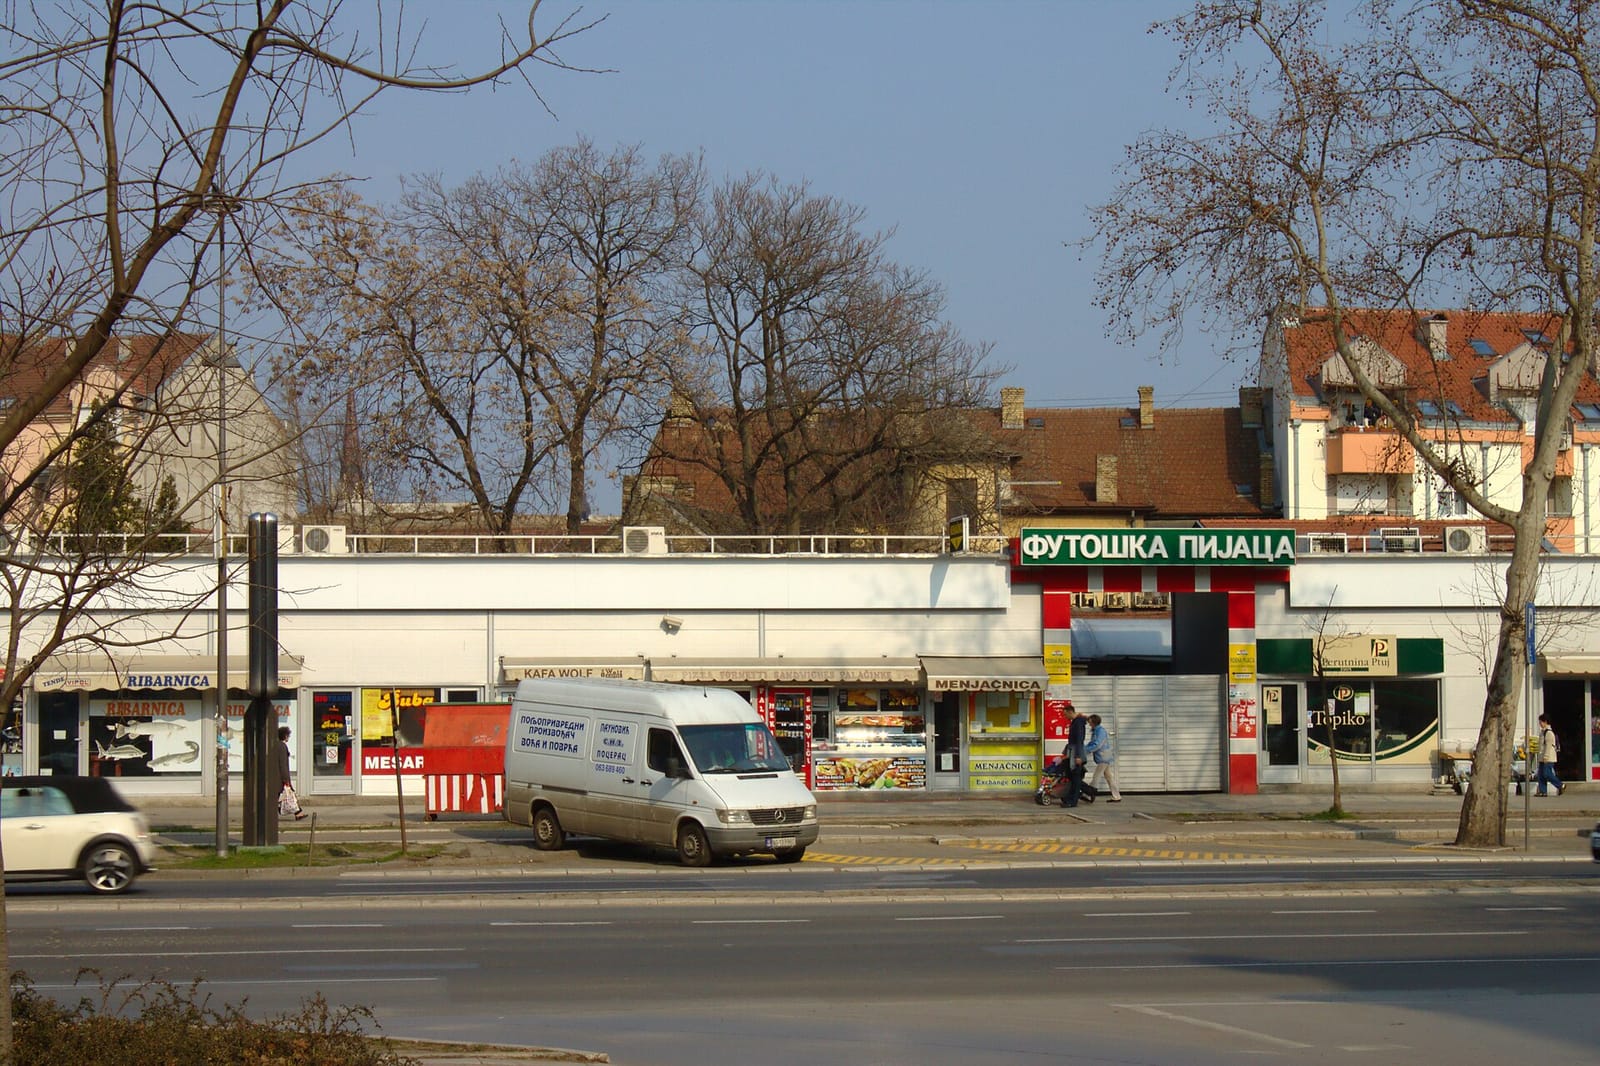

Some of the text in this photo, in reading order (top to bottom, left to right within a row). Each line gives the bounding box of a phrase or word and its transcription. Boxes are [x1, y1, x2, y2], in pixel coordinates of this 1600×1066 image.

[1022, 534, 1295, 562] ФУТОШКА ПИЈАЦА
[1322, 658, 1390, 667] Perutnina Ptuj
[524, 669, 556, 678] KAFA
[560, 669, 593, 678] WOLF
[42, 676, 65, 688] TENDE
[127, 675, 210, 688] RIBARNICA
[935, 679, 1041, 689] MENJAČNICA
[106, 702, 186, 716] RIBARNICA
[521, 716, 585, 731] ПОЉОПРИВРЕДНИ
[1312, 710, 1365, 730] Topiko
[529, 726, 576, 740] ПРОИЗВОЂАЧ
[521, 738, 541, 749] ВОЋА
[549, 742, 578, 753] ПОВРЋА
[974, 761, 1033, 770] MENJAČNICA
[976, 777, 1031, 786] Exchange Office
